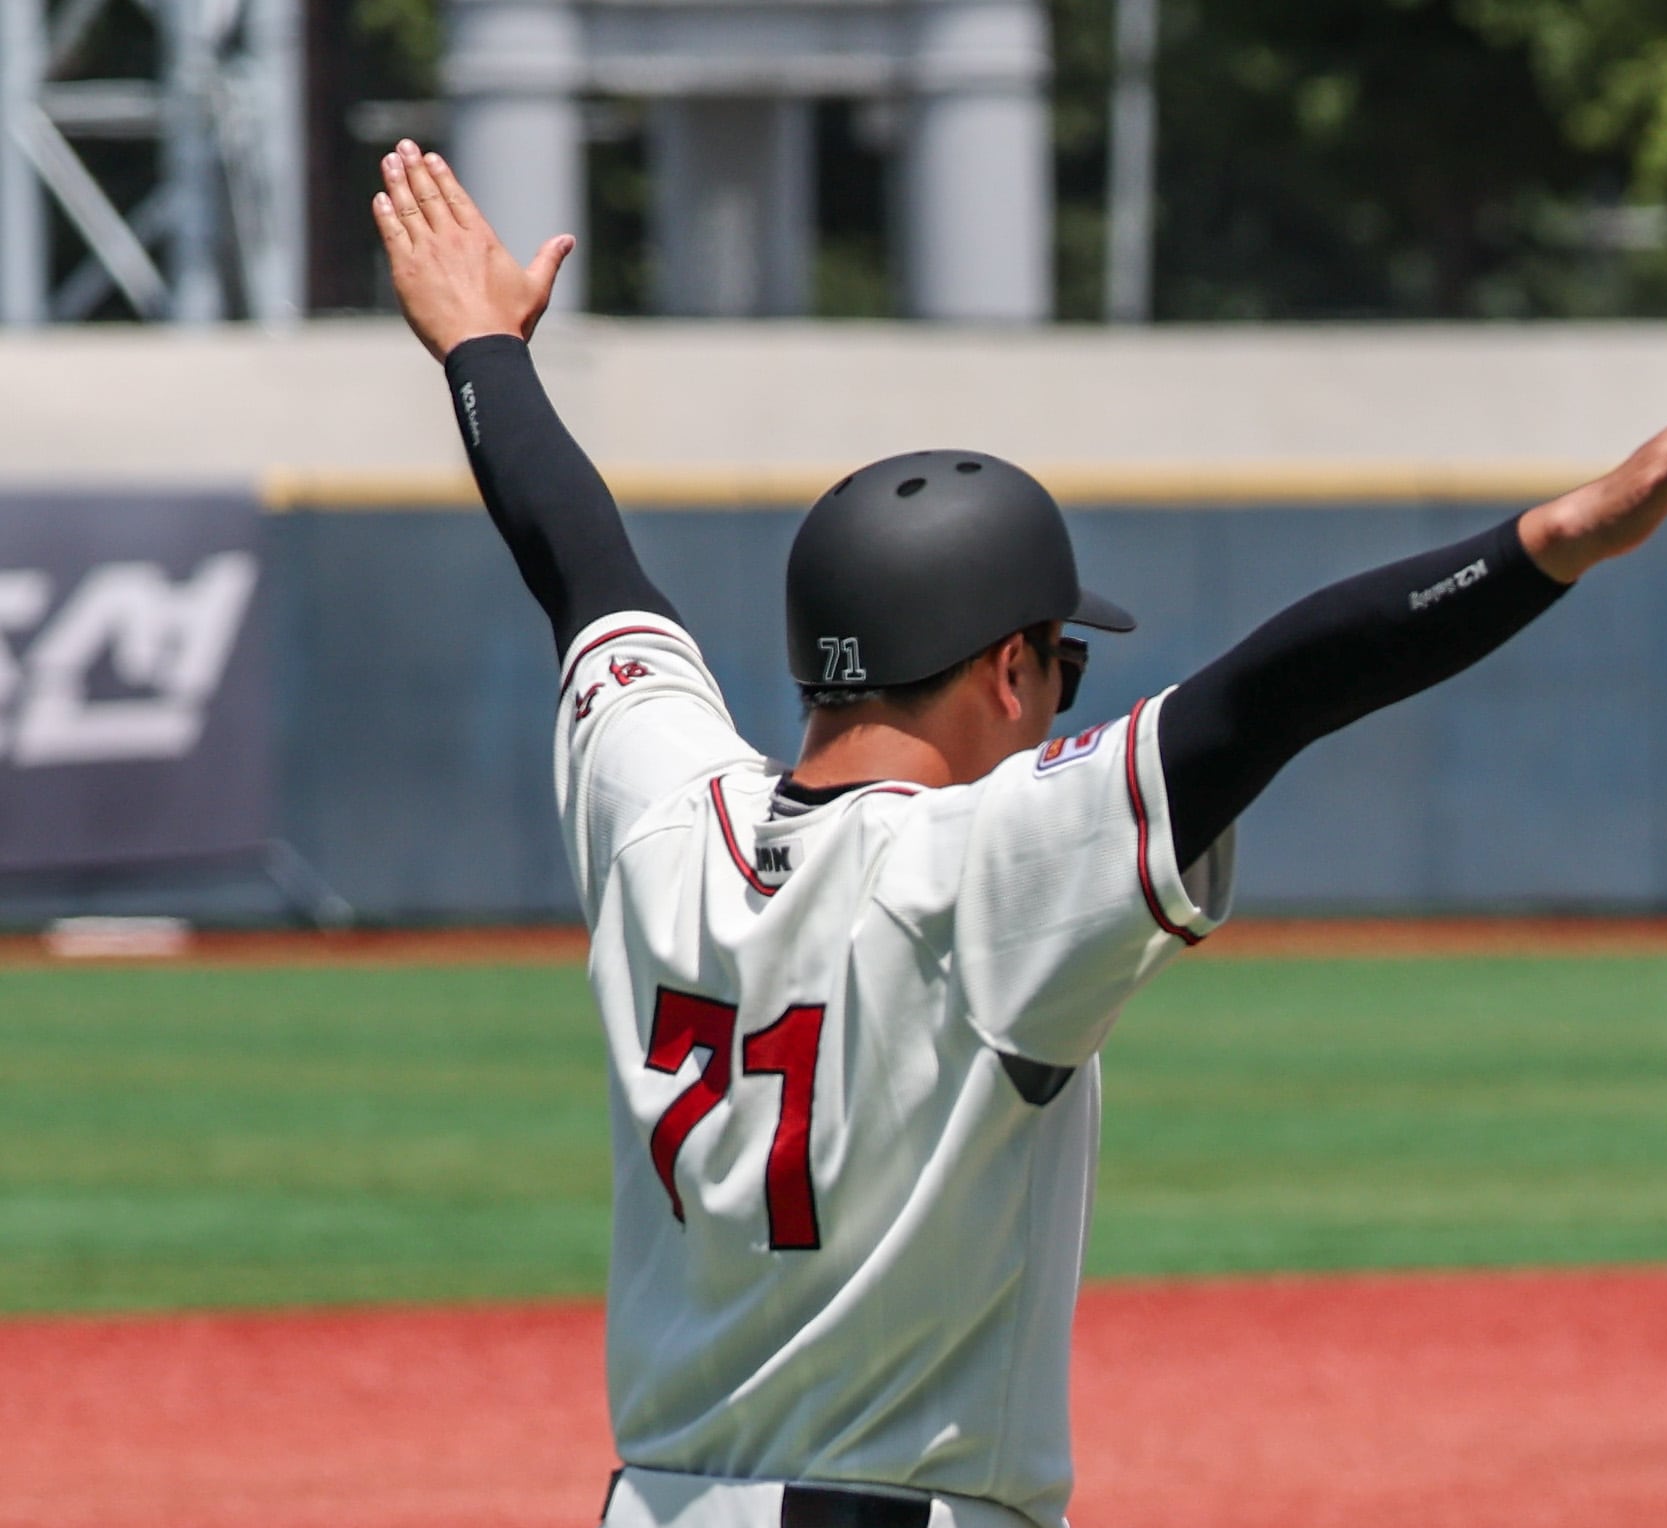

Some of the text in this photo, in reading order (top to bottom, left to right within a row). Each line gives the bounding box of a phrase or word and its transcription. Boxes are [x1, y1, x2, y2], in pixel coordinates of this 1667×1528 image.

[1453, 558, 1488, 588] K2
[817, 636, 866, 681] 71
[644, 984, 827, 1252] 71
